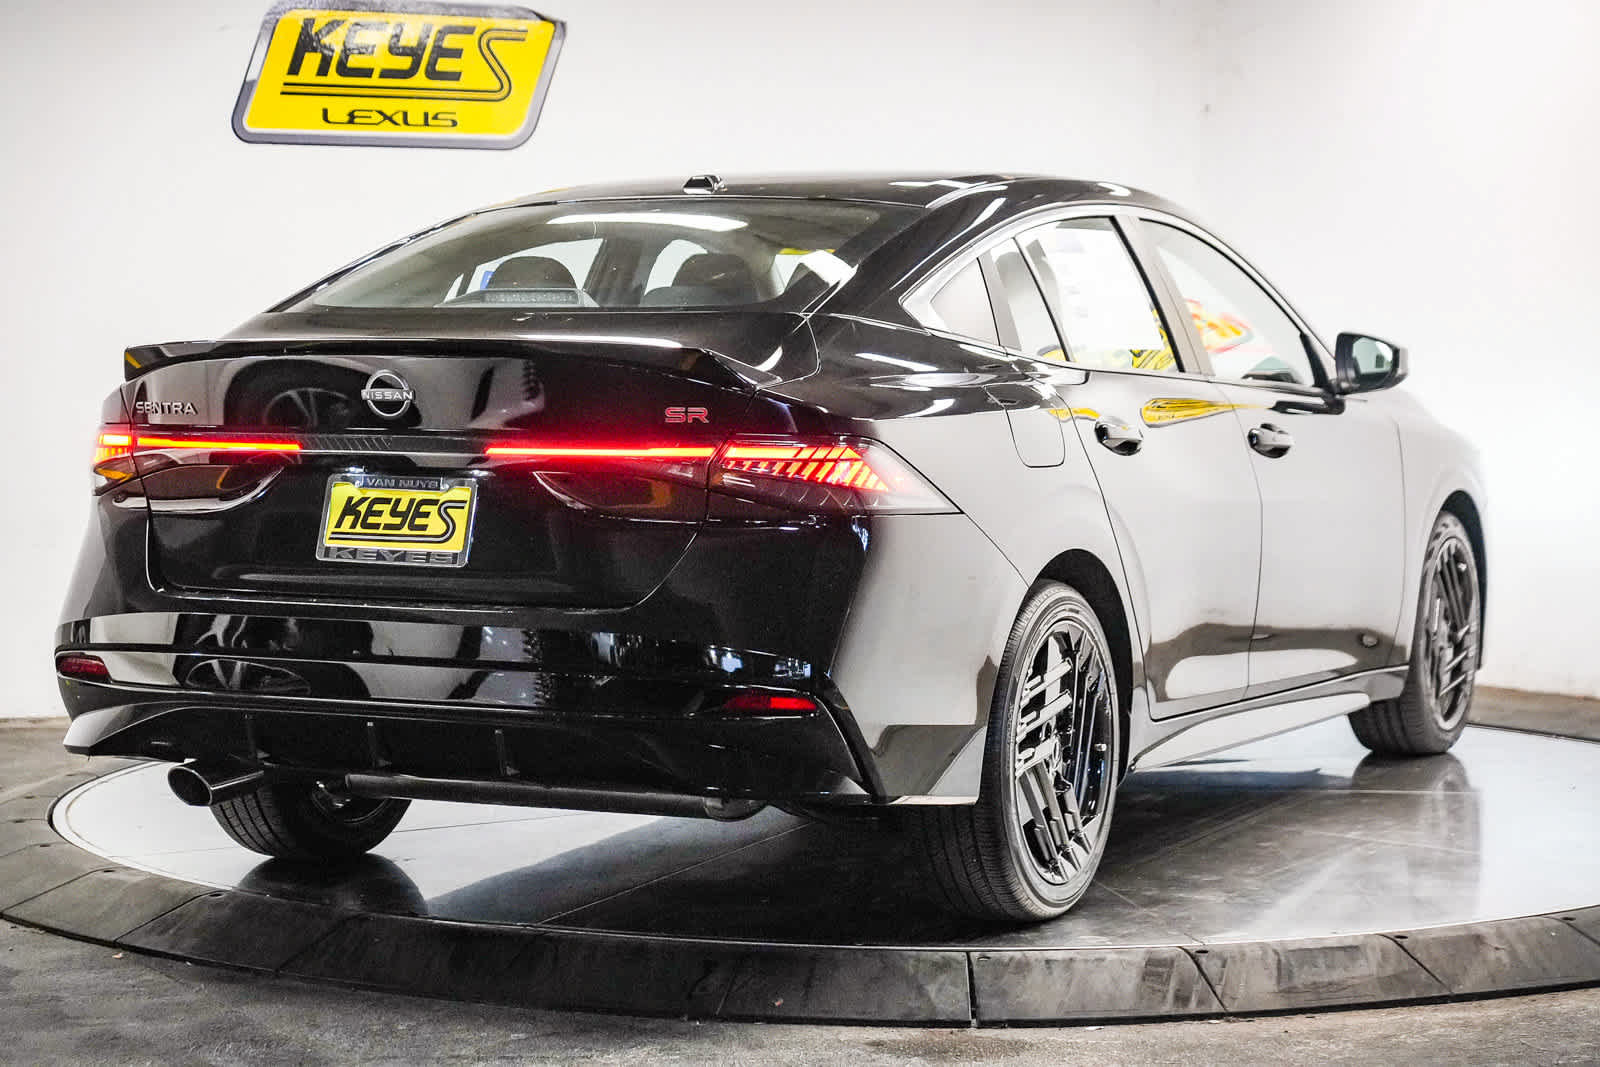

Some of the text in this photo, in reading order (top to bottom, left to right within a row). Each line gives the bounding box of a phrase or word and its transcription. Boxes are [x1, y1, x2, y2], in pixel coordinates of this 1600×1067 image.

[281, 17, 528, 102] KEYES
[322, 107, 459, 128] LEXUS
[361, 390, 413, 400] NISSAN
[135, 401, 198, 415] SENTRA
[664, 406, 710, 424] SR
[366, 477, 395, 488] VAN
[329, 496, 468, 544] KEYES
[329, 548, 453, 564] KEYES
